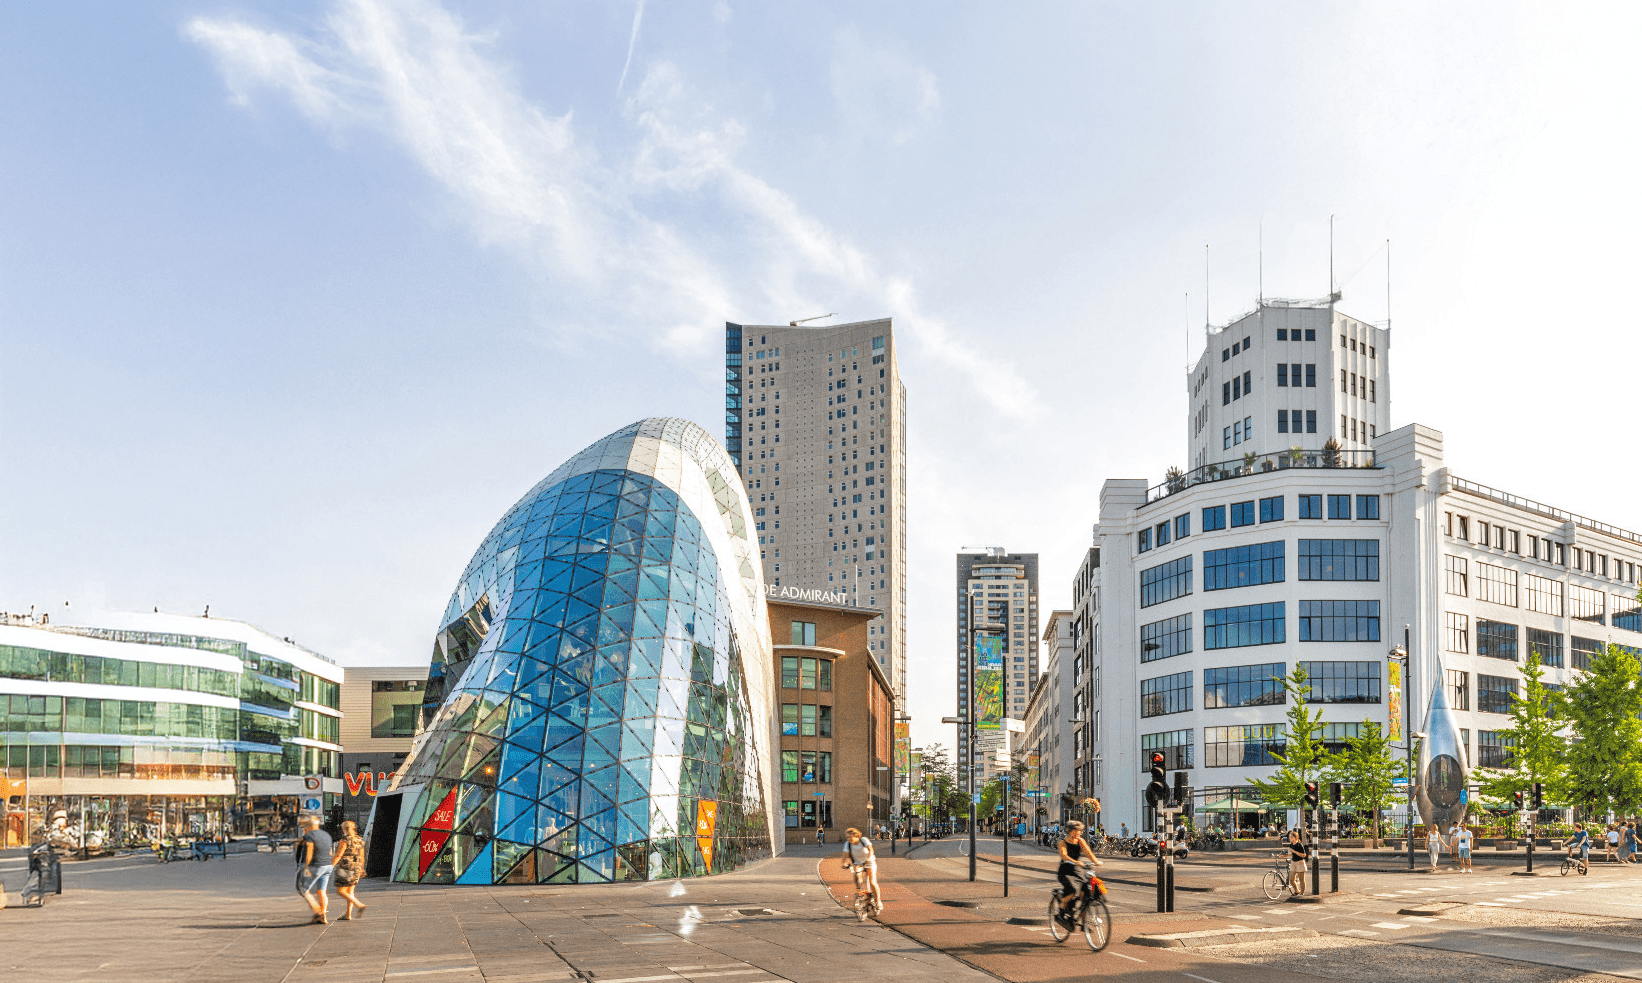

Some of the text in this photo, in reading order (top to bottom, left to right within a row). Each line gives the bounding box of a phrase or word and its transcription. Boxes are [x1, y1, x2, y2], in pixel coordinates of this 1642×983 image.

[780, 585, 848, 604] ADMIRANT
[1222, 726, 1274, 741] IGLUU
[344, 771, 397, 797] VU
[434, 809, 453, 822] SALE
